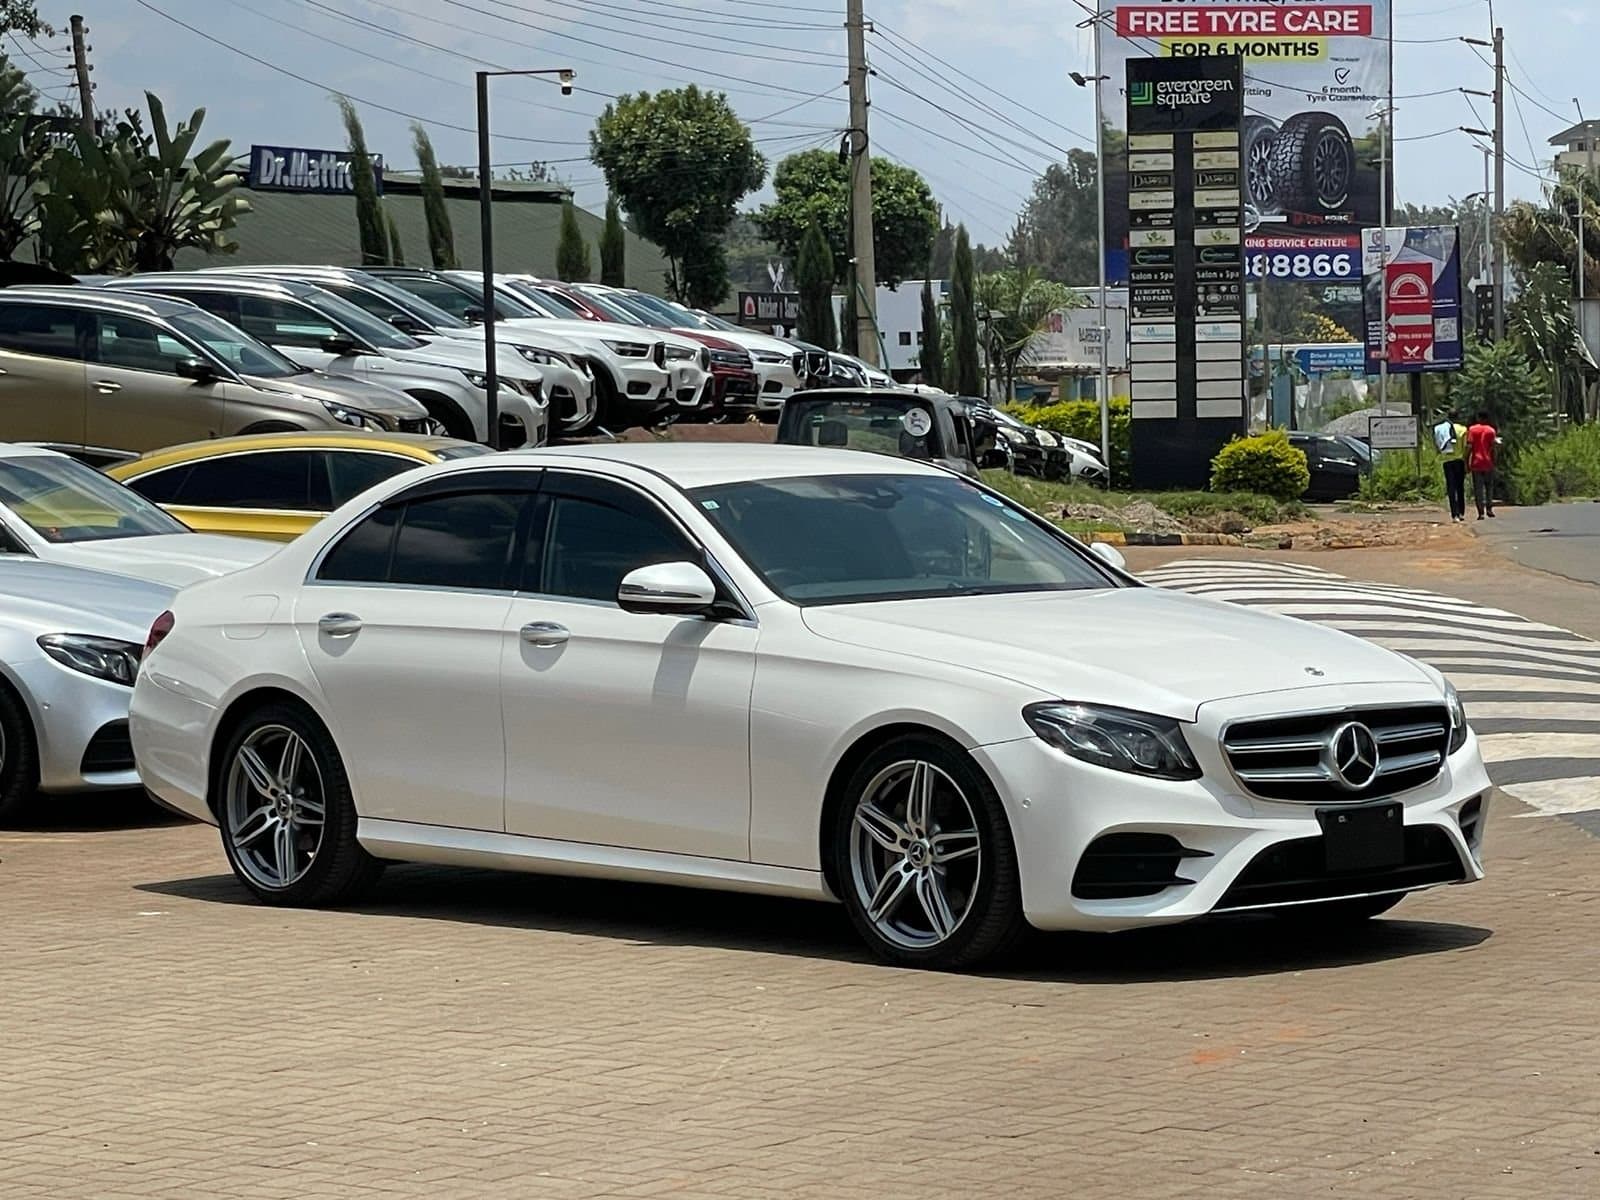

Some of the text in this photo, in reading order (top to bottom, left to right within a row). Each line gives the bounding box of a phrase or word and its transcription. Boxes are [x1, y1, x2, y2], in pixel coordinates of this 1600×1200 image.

[1128, 10, 1360, 33] FREE TYRE CARE
[1171, 42, 1320, 57] FOR 6 MONTHS
[1156, 80, 1234, 94] evergreen
[1322, 85, 1362, 94] 6 month
[1156, 92, 1211, 109] square
[1267, 238, 1306, 248] SERVICE
